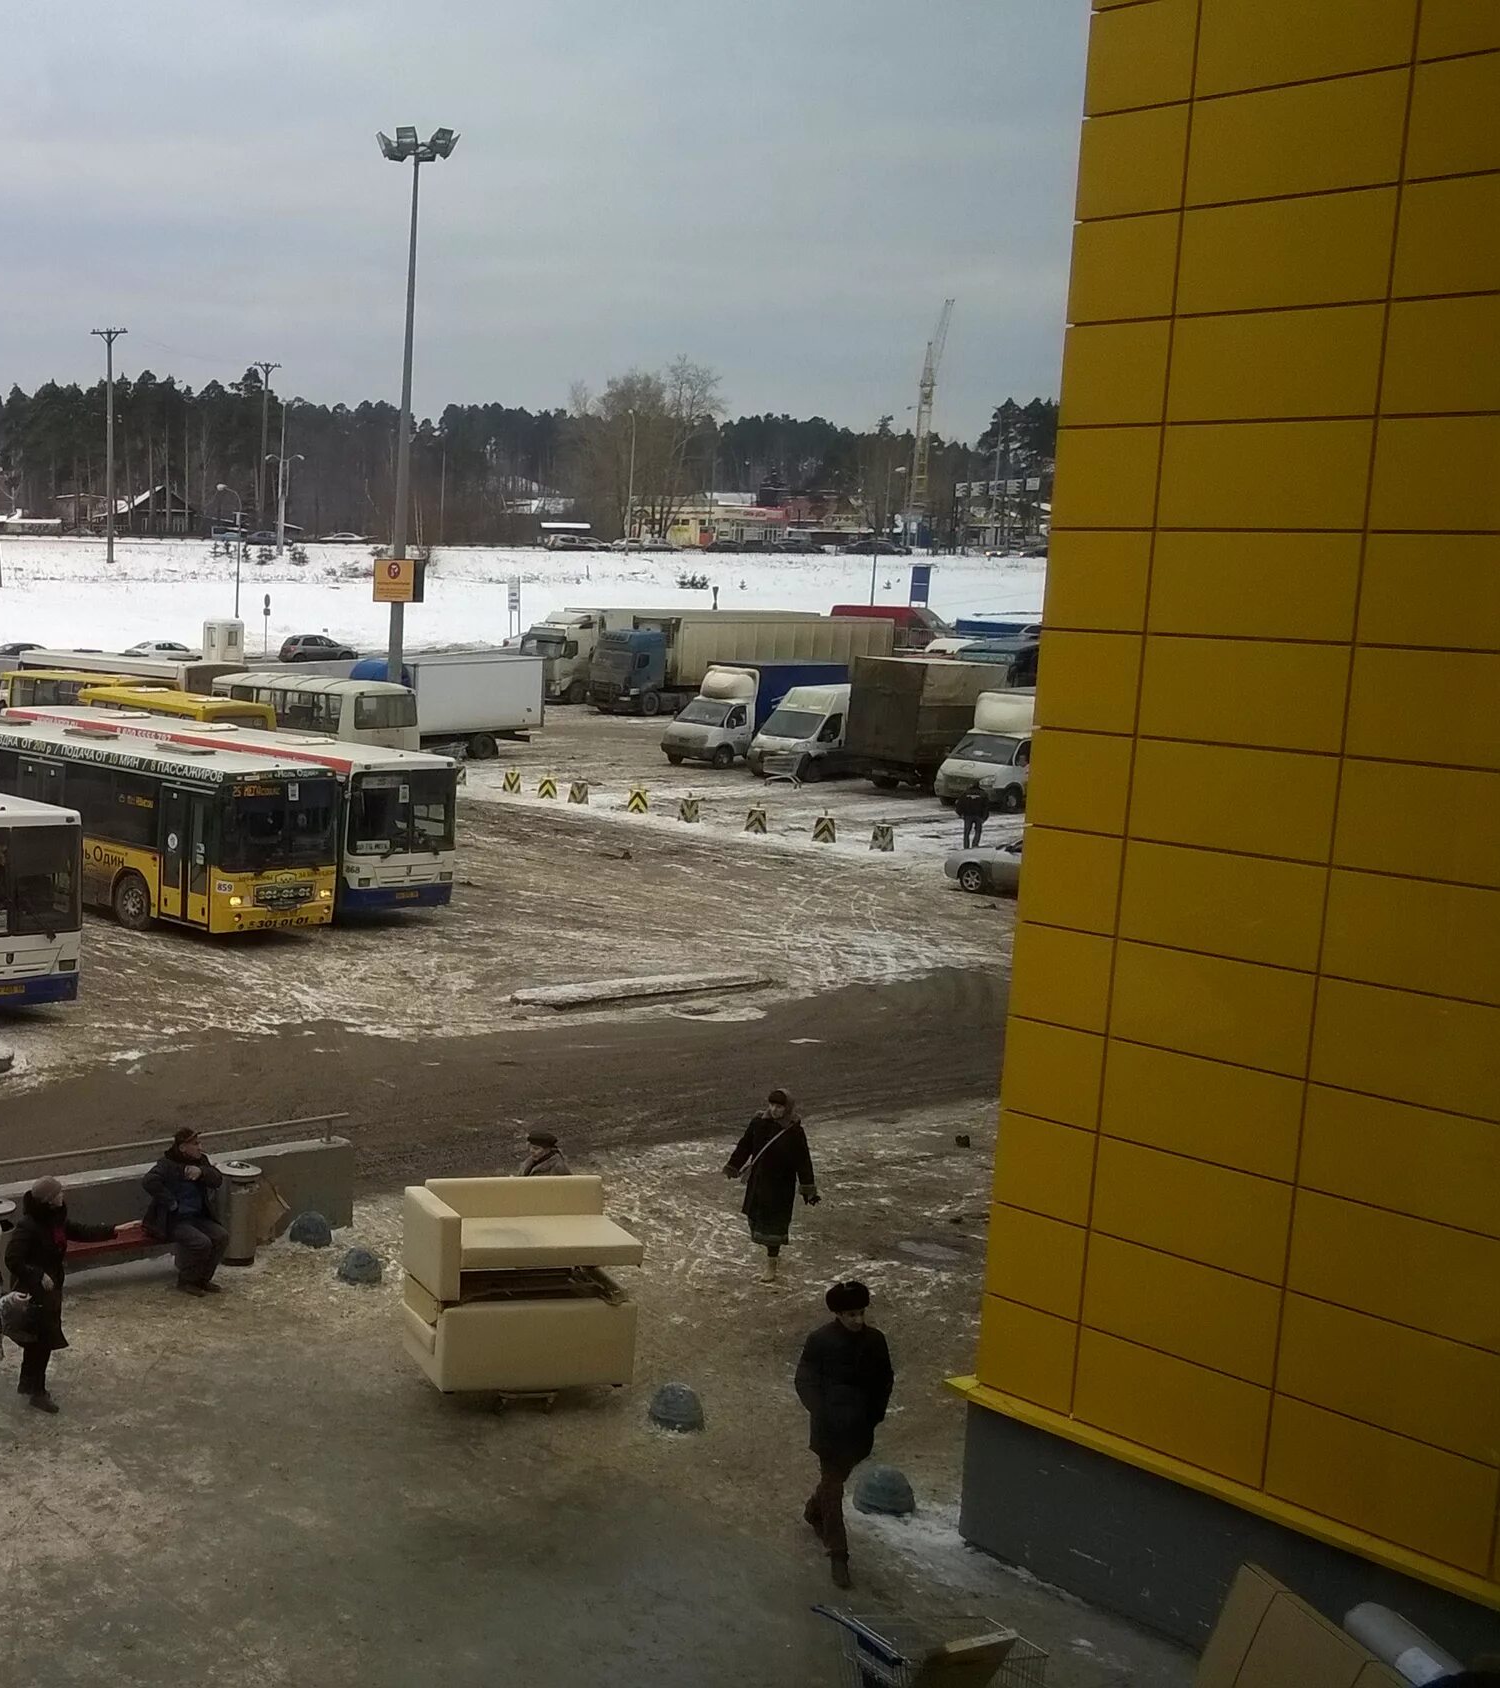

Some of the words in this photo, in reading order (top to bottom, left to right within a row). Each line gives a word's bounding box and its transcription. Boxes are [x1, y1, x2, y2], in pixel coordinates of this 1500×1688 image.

[21, 739, 33, 749] ОТ
[33, 740, 46, 753] 200
[61, 746, 96, 760] ПОДАЧА
[95, 750, 108, 763] ОТ
[108, 754, 118, 765] 10
[119, 756, 140, 769] МИН
[150, 760, 156, 772] 8
[157, 761, 224, 783] ПАССАЖИРОВ
[93, 846, 124, 867] Один
[217, 882, 233, 892] 859
